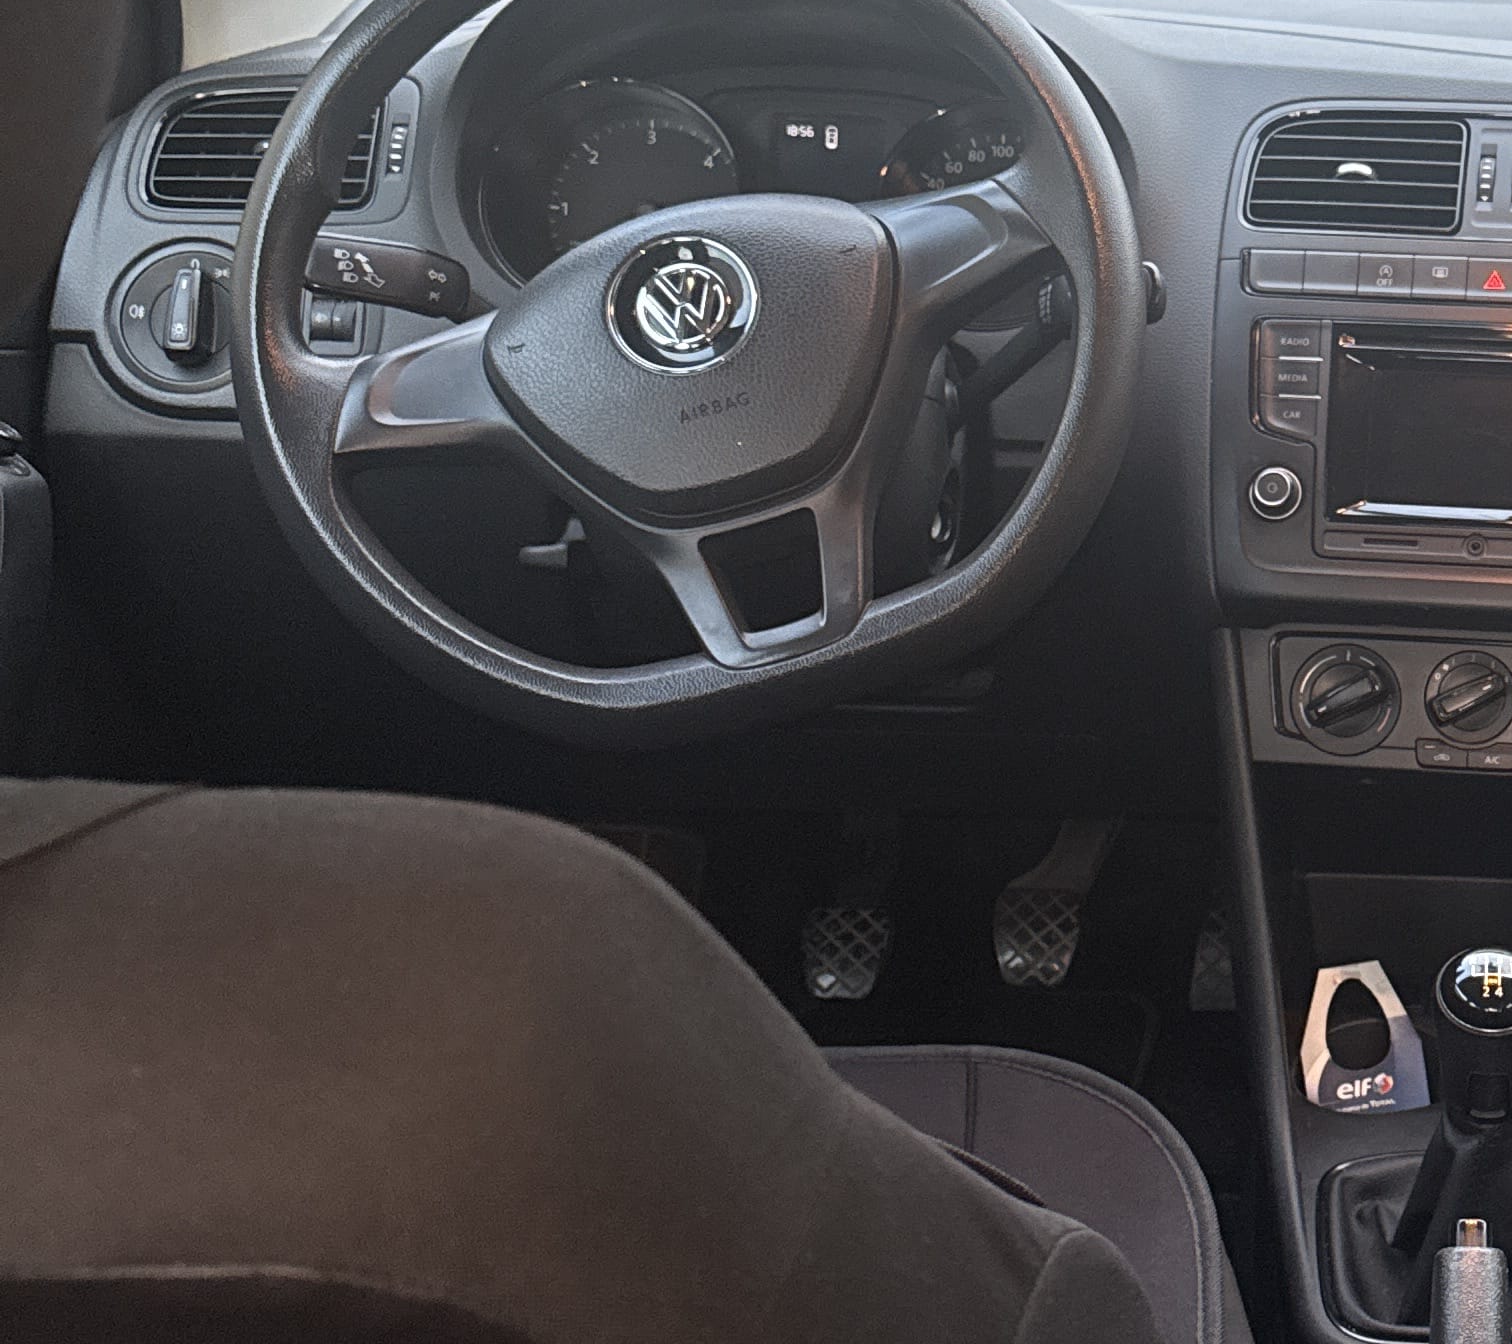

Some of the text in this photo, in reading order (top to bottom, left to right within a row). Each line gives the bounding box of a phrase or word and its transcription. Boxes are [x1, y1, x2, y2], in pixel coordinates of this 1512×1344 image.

[647, 130, 657, 145] 3
[785, 124, 815, 138] 18:56
[587, 150, 599, 165] 2
[968, 149, 986, 163] 80
[992, 145, 1015, 158] 100
[703, 155, 714, 169] 4
[945, 161, 963, 174] 60
[1376, 278, 1394, 288] OFF
[1280, 337, 1310, 346] RADIO
[1278, 373, 1308, 382] MEDIA
[680, 391, 751, 425] AIRBAG
[1282, 410, 1301, 419] CAR
[1484, 755, 1501, 765] A/C
[1482, 986, 1504, 998] 2 4
[1336, 1076, 1373, 1100] elf
